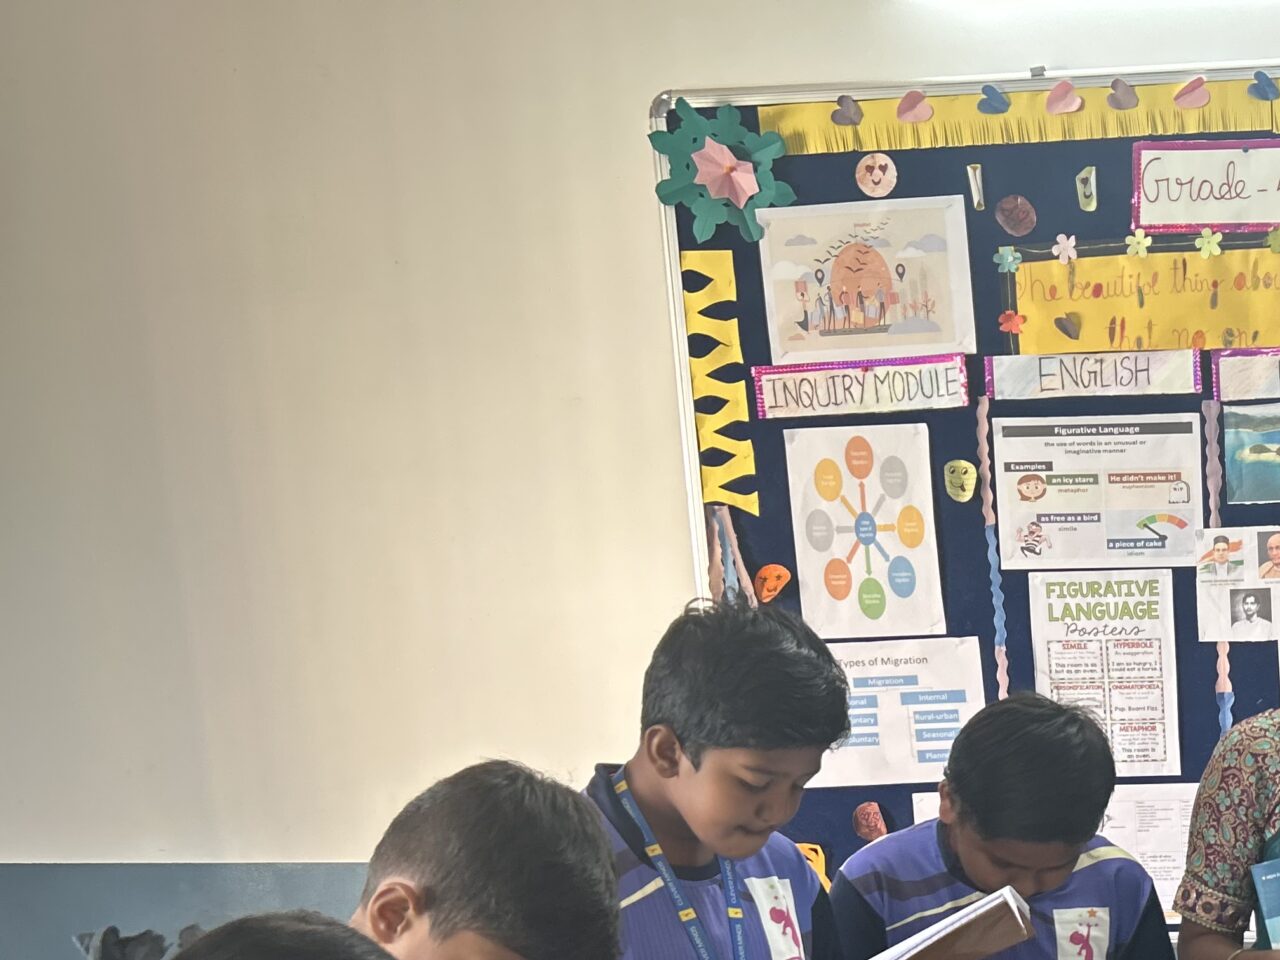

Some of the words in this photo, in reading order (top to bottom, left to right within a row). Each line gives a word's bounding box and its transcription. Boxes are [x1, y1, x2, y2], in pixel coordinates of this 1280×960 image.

[1038, 355, 1151, 392] ENGLISH
[766, 371, 867, 409] INQUIRY
[873, 367, 958, 403] MODULE
[1054, 426, 1097, 435] Figurative
[1099, 425, 1140, 434] Language
[1010, 463, 1046, 472] Examples
[1063, 475, 1073, 485] icy
[1050, 514, 1066, 522] free
[1083, 513, 1098, 521] bird
[1115, 540, 1136, 549] piece
[1045, 579, 1160, 598] FIGURATIVE
[1047, 601, 1160, 622] LANGUAGE
[1064, 622, 1145, 637] Posters
[1062, 642, 1088, 650] SIMILE
[1113, 641, 1153, 649] HYPERBOLE
[868, 657, 878, 666] of
[881, 656, 928, 667] Migration
[868, 678, 904, 686] Migration
